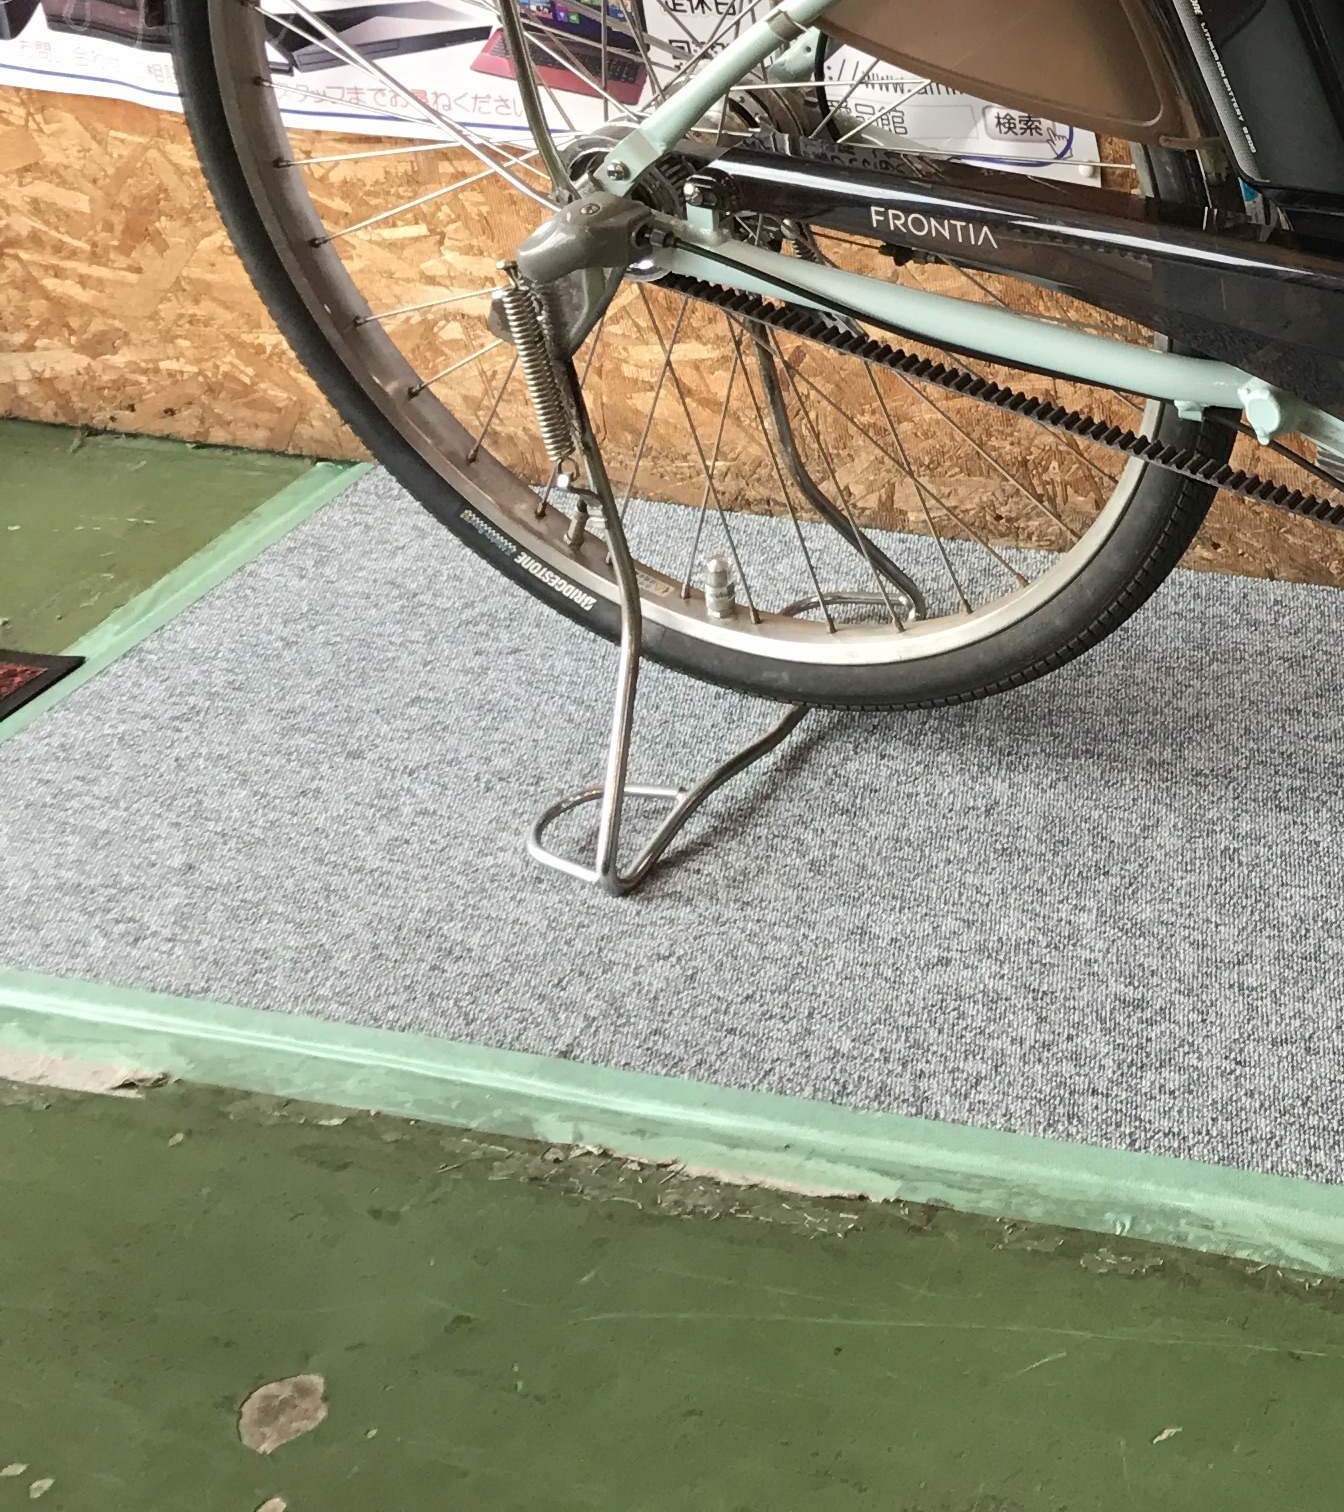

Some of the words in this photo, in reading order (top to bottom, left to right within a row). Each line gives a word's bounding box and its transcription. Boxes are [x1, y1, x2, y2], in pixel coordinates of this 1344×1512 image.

[994, 110, 1045, 138] 検索
[870, 205, 998, 249] FRONTIA
[513, 551, 598, 612] BRIDGESTONE
